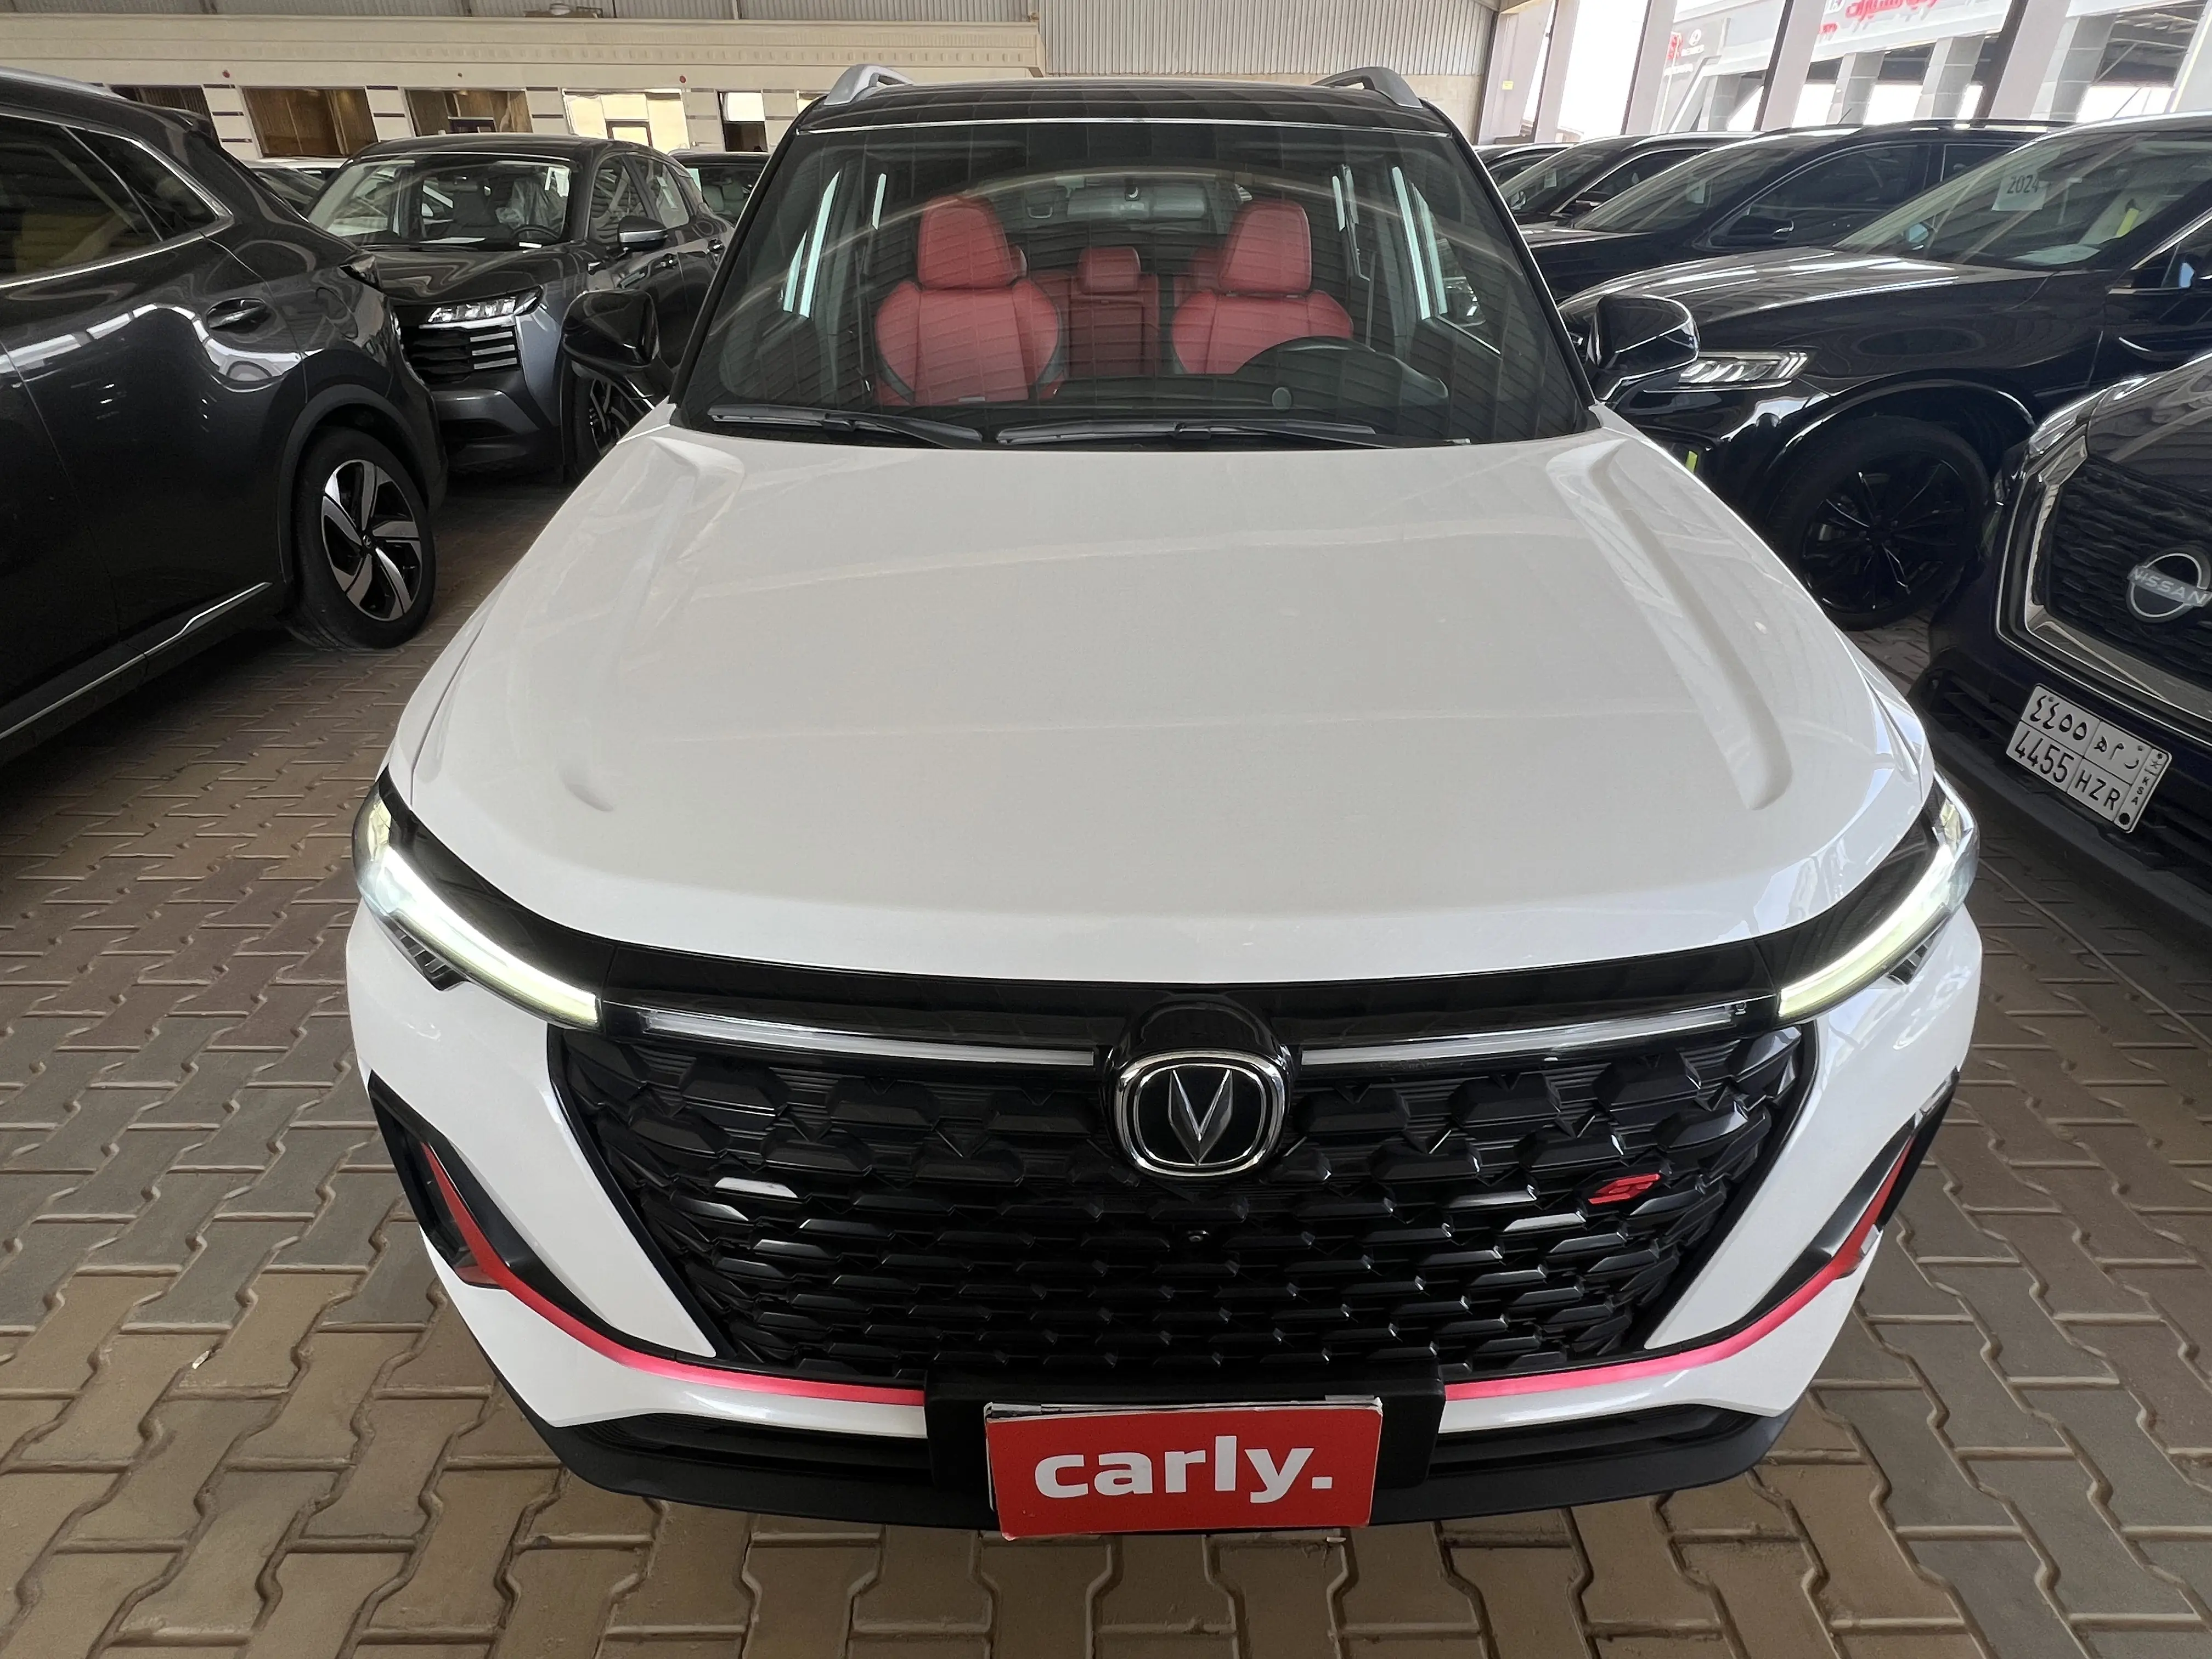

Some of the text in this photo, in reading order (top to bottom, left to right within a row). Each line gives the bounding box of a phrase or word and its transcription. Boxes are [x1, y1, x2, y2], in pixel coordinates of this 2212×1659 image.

[2006, 174, 2040, 194] 2024
[2130, 568, 2209, 604] NISSAN
[2015, 731, 2121, 811] 4455 HZR
[1034, 1435, 1333, 1504] carly.
